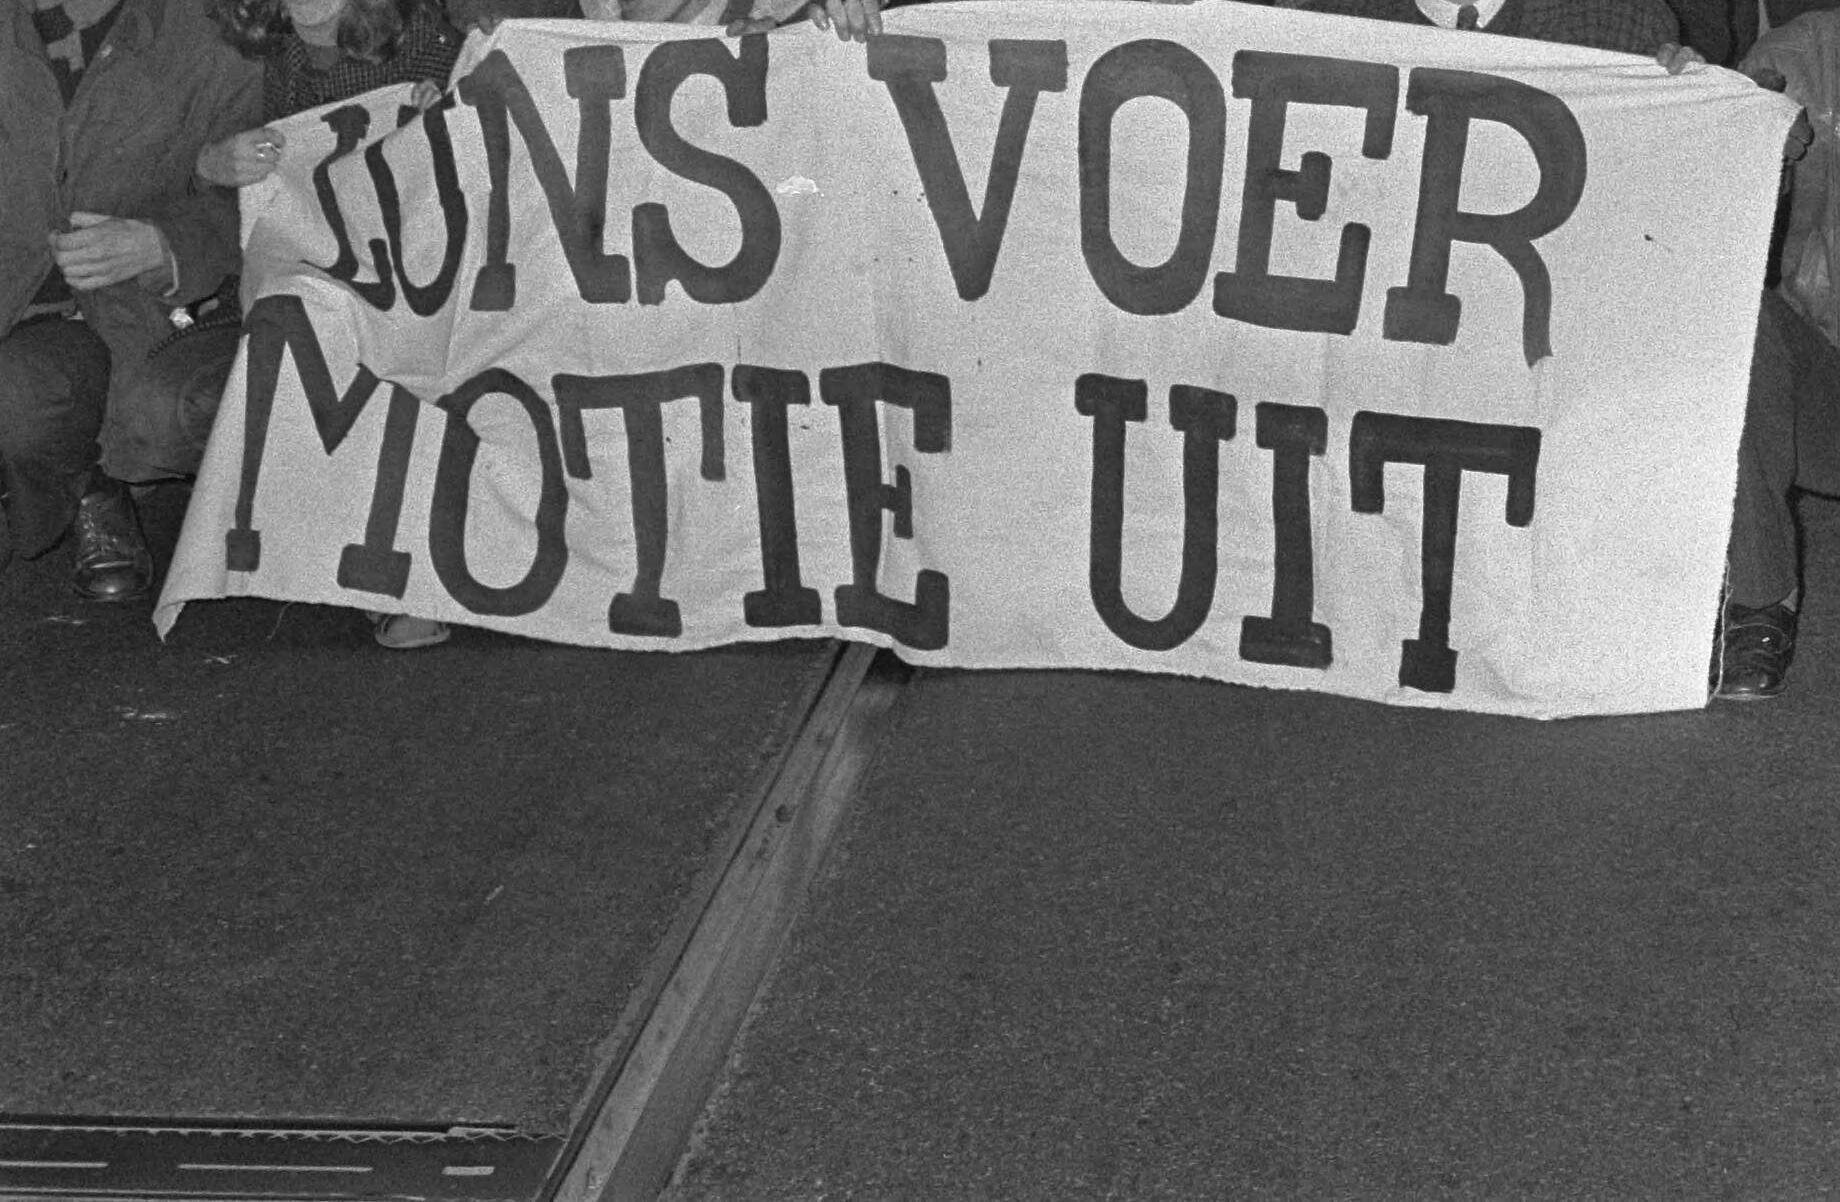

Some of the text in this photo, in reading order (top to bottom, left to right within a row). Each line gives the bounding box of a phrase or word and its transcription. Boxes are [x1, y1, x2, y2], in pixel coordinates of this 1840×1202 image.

[302, 34, 1588, 369] LUNS VOER
[226, 294, 1542, 694] MOTIE UIT
